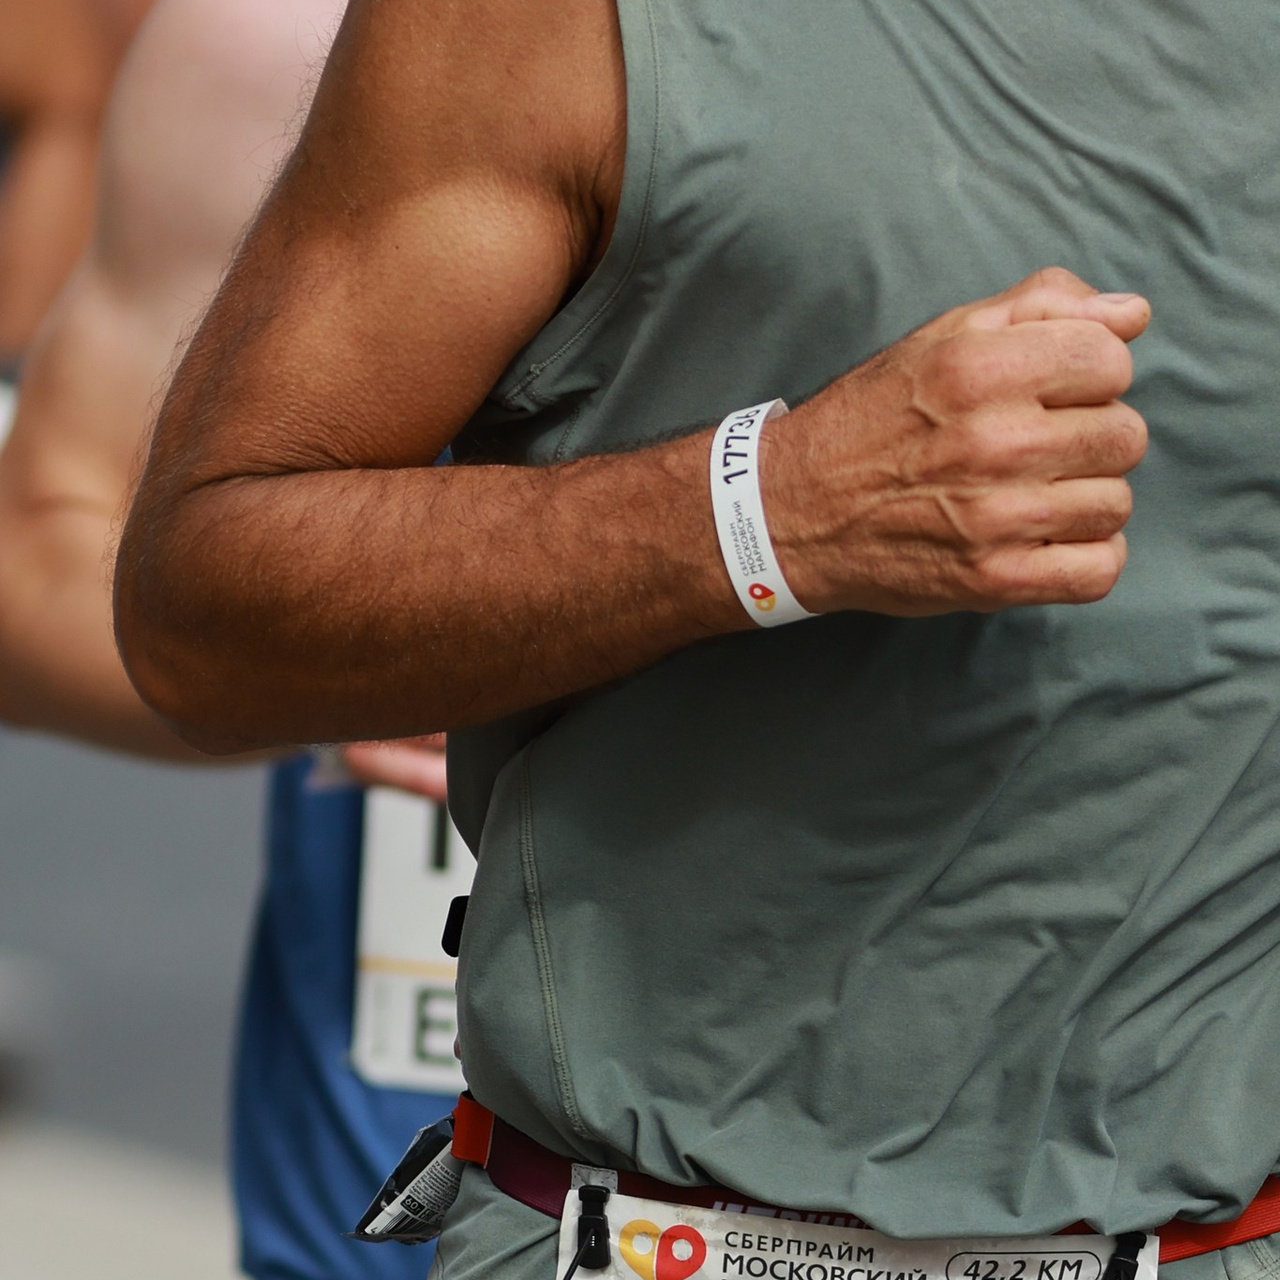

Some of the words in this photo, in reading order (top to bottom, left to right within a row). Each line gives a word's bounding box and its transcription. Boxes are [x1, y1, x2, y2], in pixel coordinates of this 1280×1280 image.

[722, 409, 761, 485] 17736
[745, 517, 767, 572] МАРАФОН
[725, 1231, 875, 1263] СБЕРПРАЙМ
[1037, 1259, 1083, 1280] КМ
